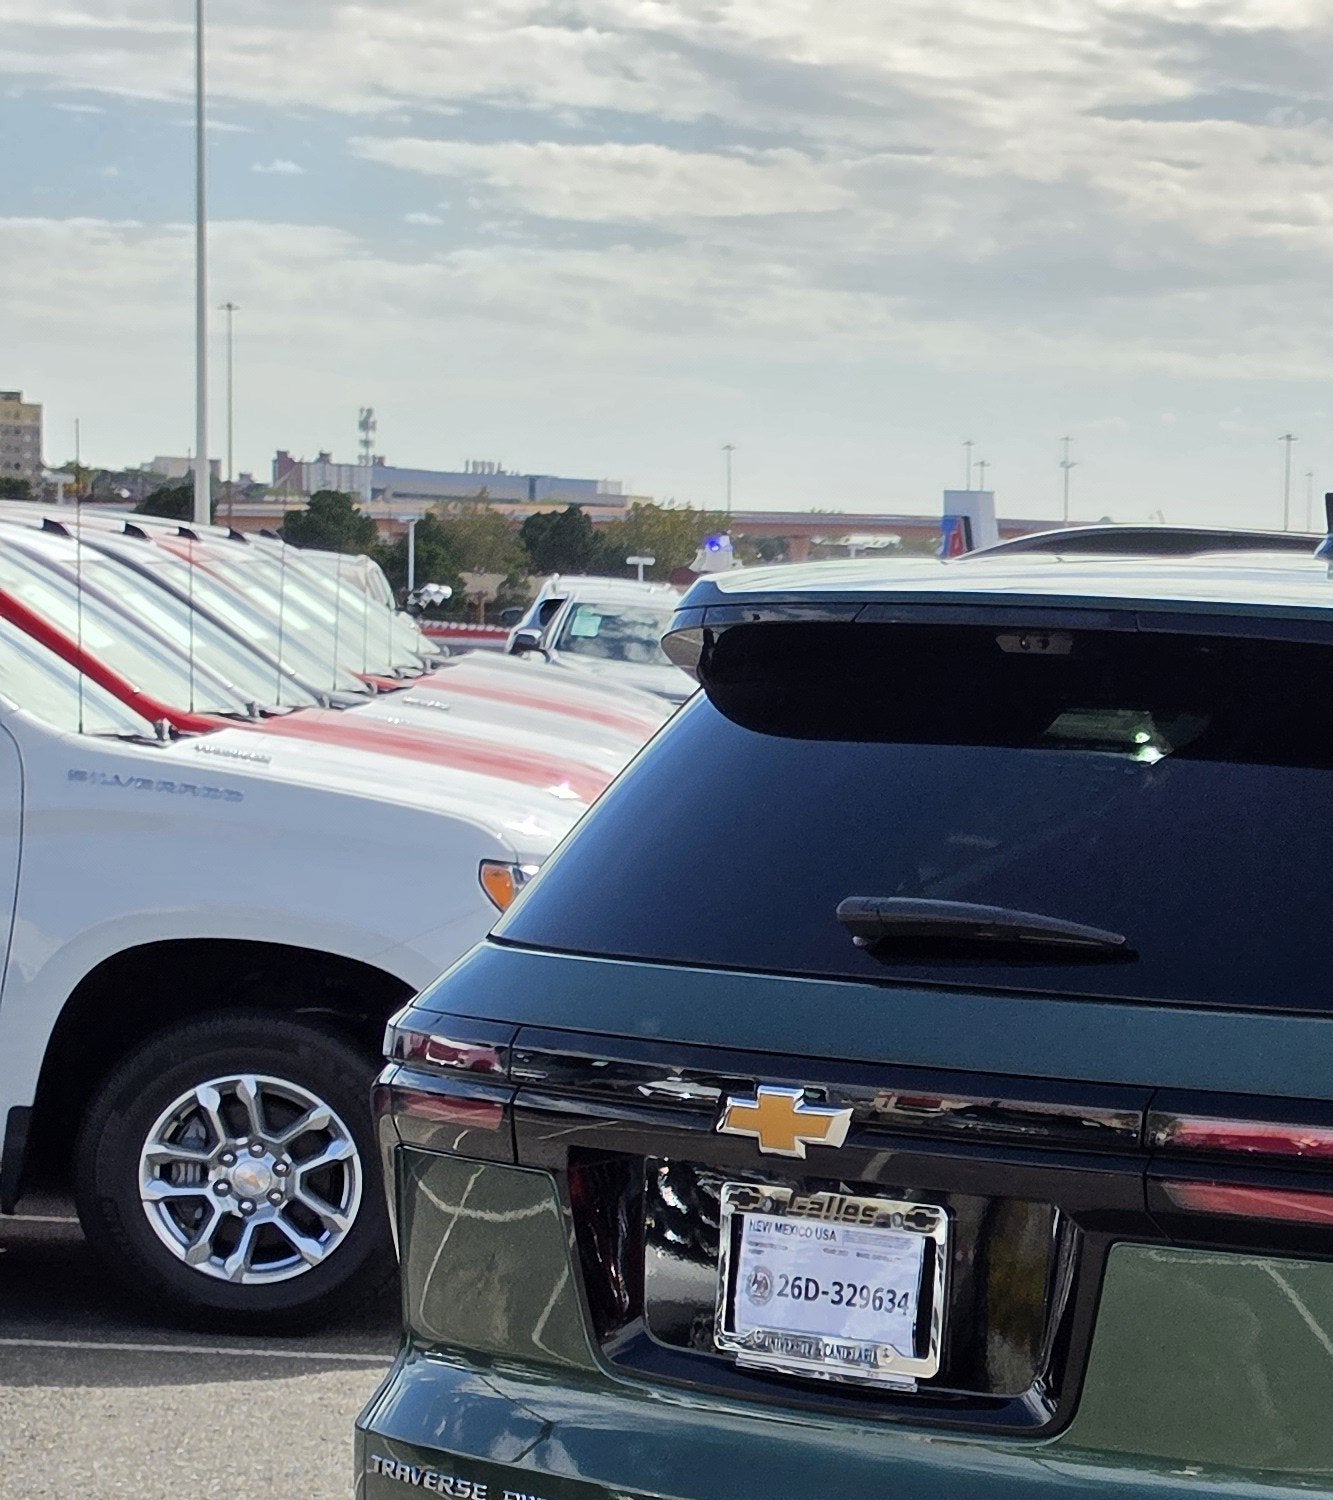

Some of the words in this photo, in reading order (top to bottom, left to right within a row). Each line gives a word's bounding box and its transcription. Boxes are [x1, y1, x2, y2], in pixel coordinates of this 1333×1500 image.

[67, 769, 244, 802] SILVERADO
[749, 1218, 773, 1233] NEW
[774, 1220, 813, 1238] MEXICO
[814, 1229, 837, 1242] USA
[776, 1273, 910, 1316] 26D-329634
